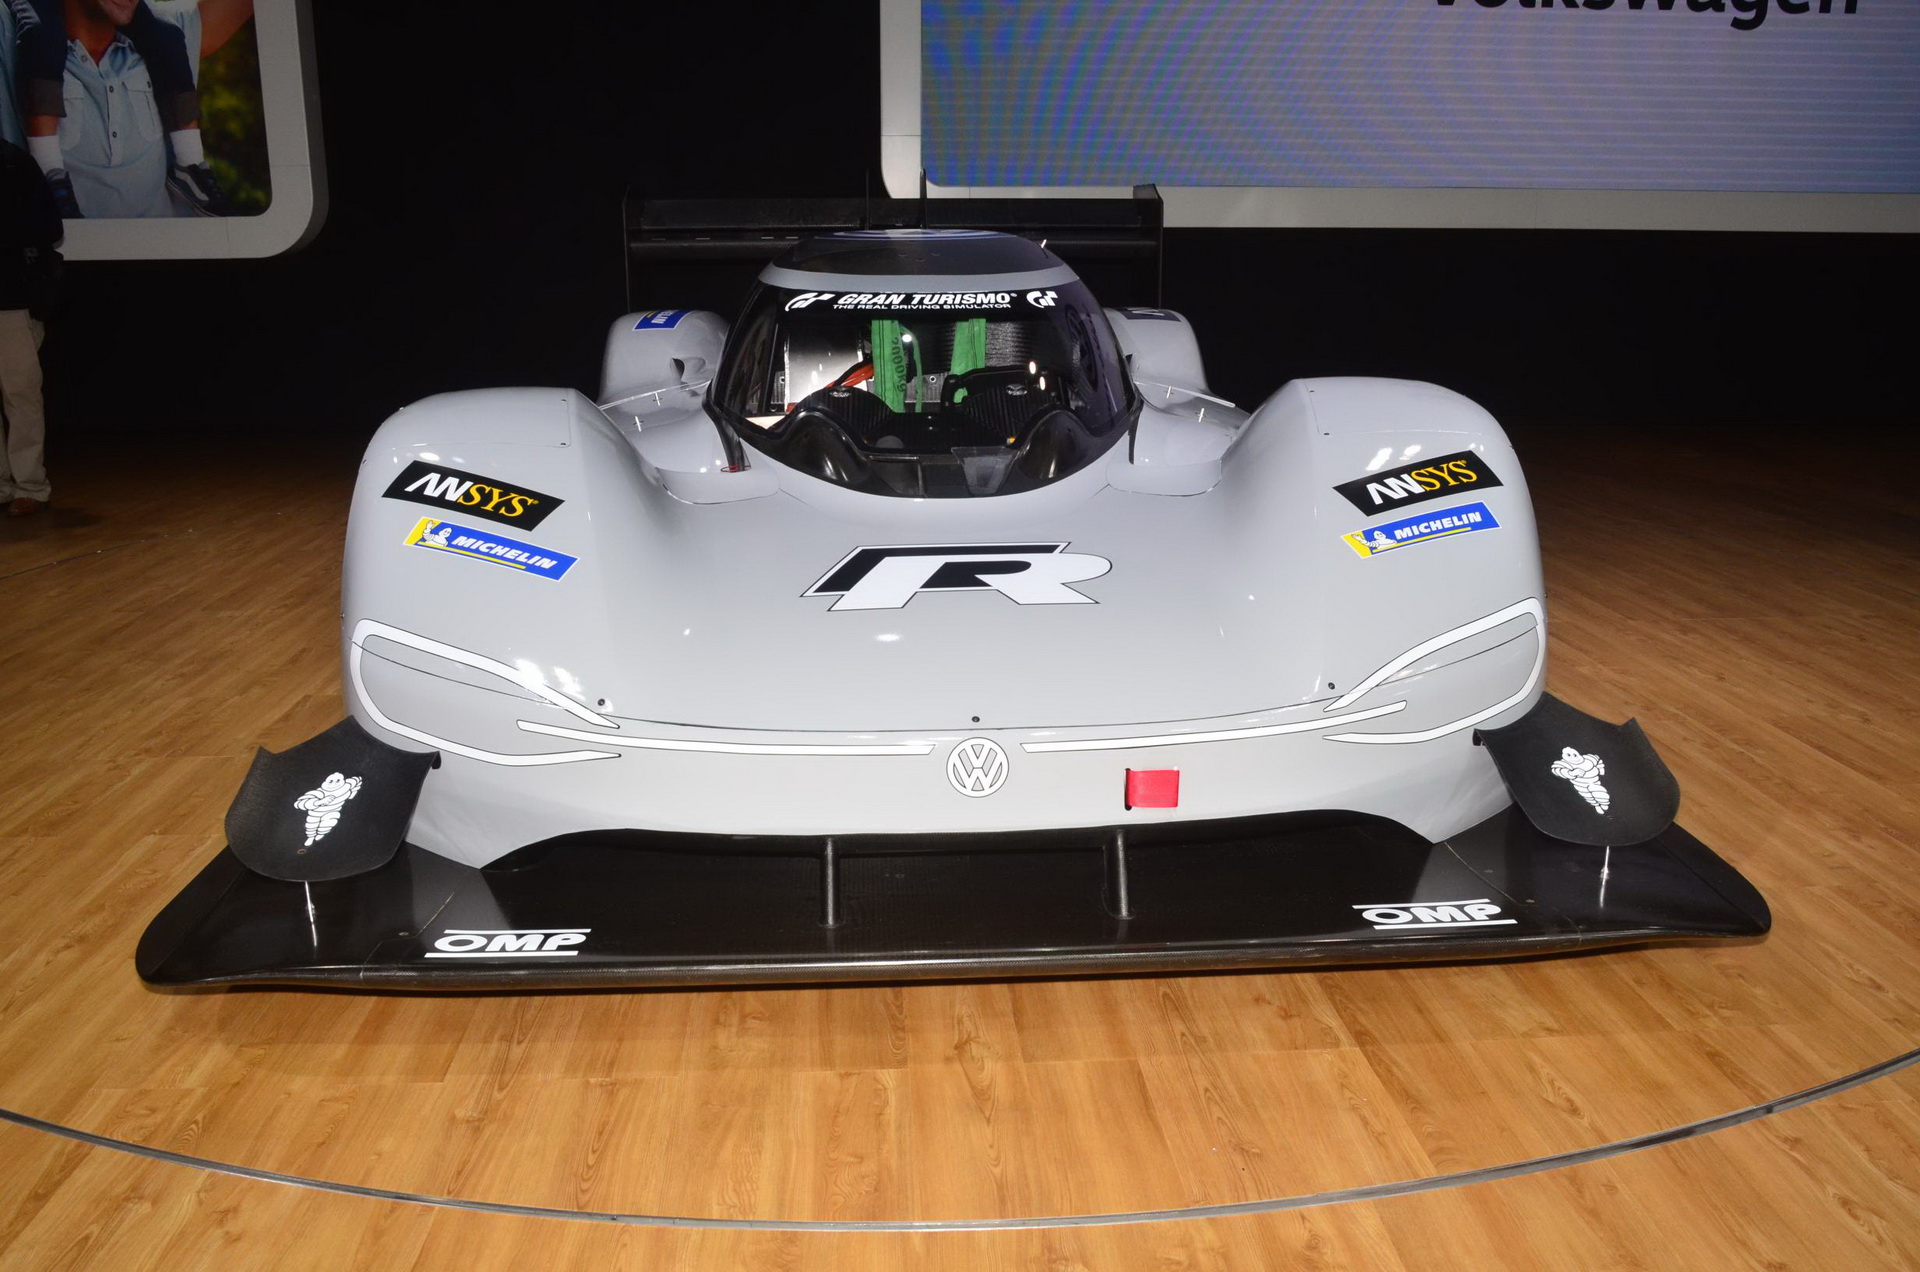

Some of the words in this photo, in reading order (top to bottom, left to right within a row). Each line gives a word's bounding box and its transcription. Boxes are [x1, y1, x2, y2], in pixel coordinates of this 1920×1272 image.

[837, 293, 906, 305] GRAN
[911, 292, 1011, 305] TURISMO
[404, 472, 534, 517] ANSYS
[1366, 460, 1478, 505] ANSYS
[1394, 511, 1483, 540] MICHELIN
[451, 535, 558, 570] MICHELIN
[1361, 903, 1502, 924] OMP
[434, 932, 587, 952] OMP
